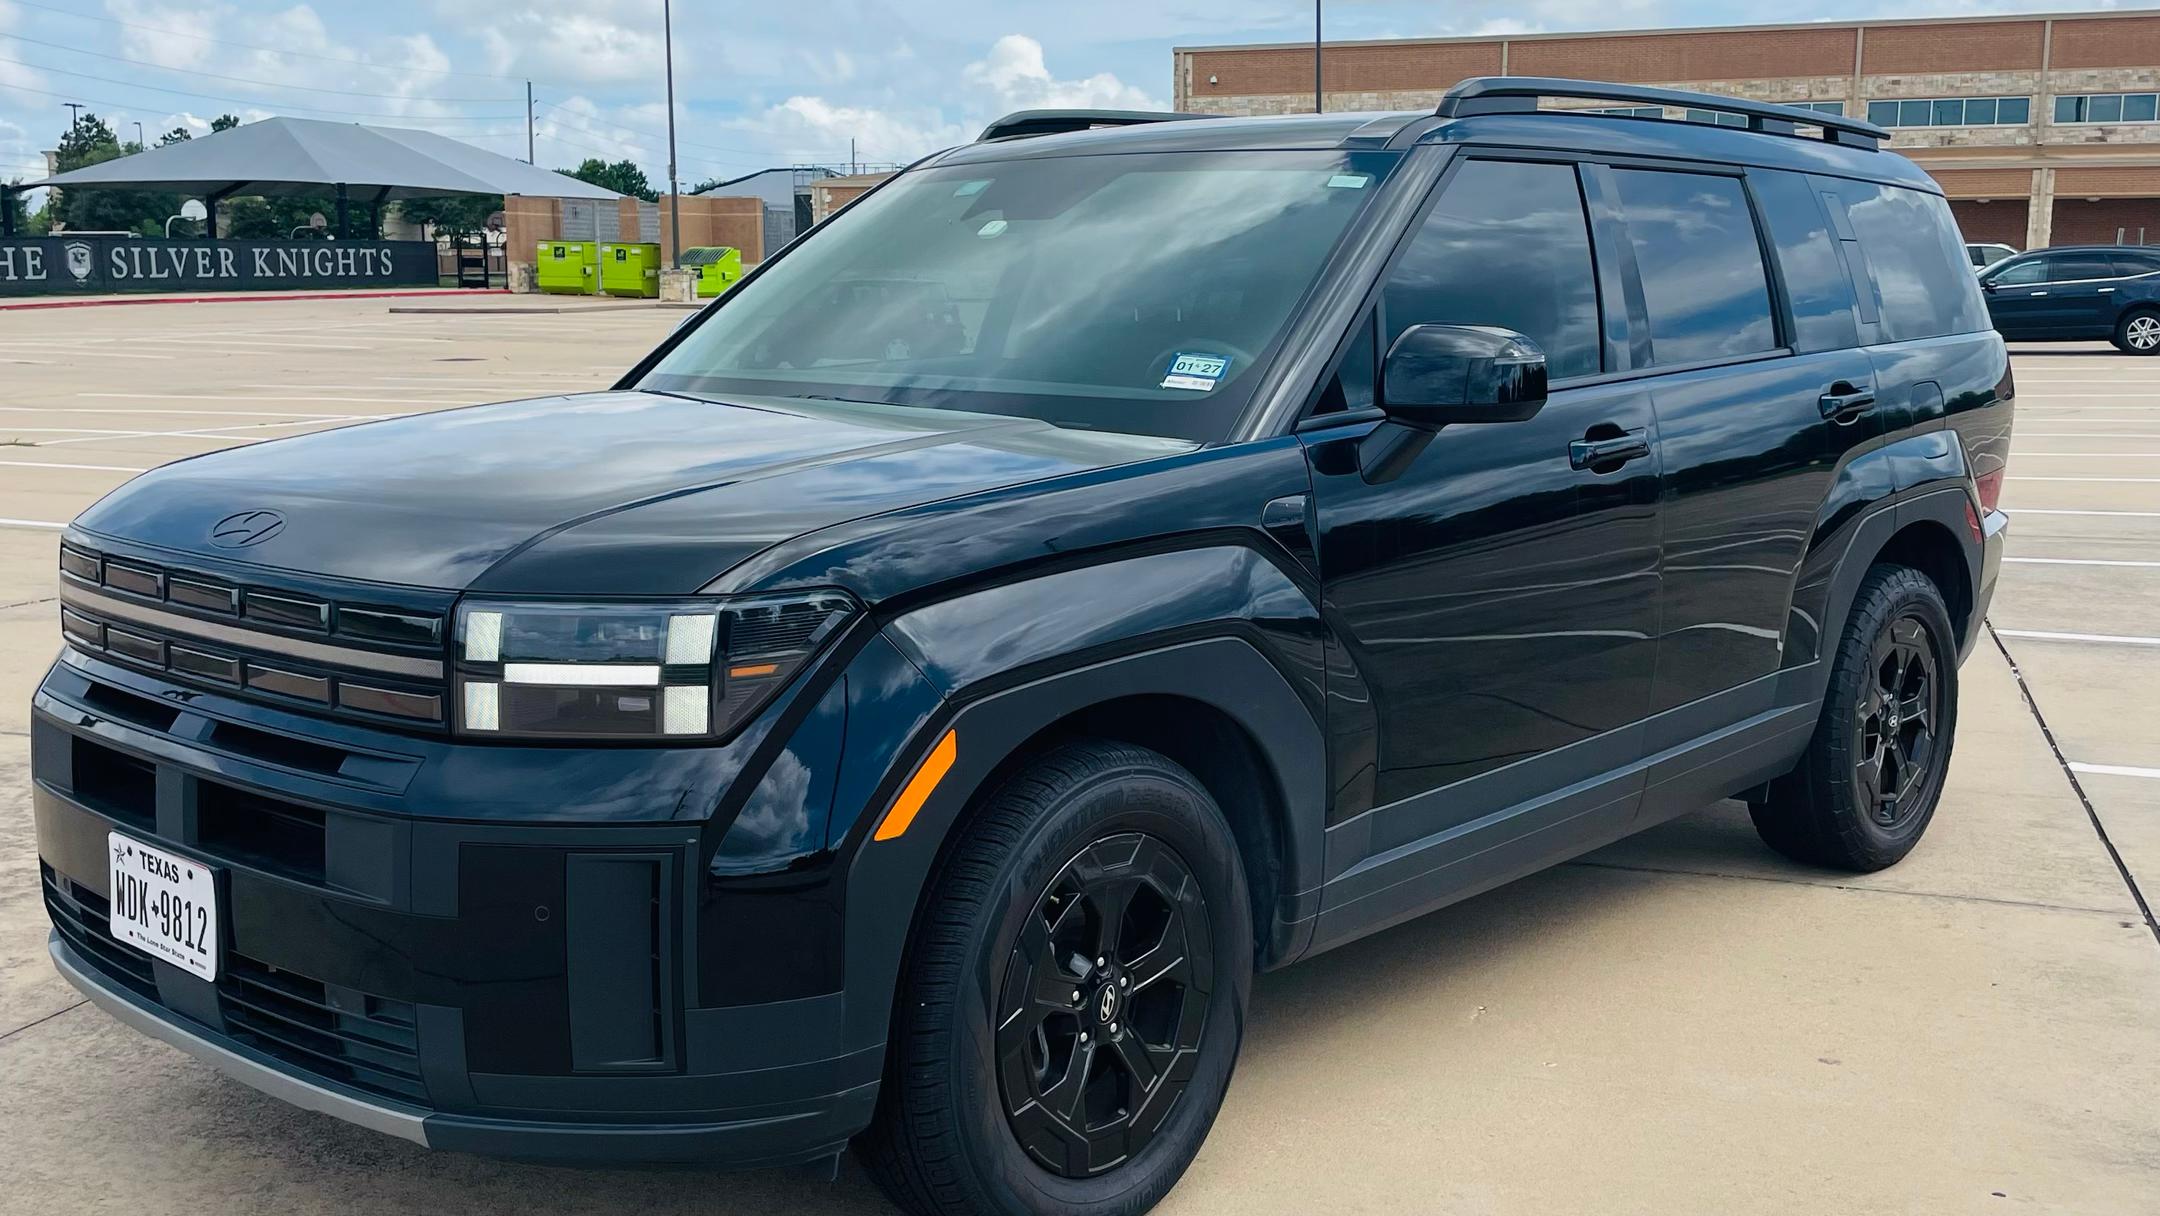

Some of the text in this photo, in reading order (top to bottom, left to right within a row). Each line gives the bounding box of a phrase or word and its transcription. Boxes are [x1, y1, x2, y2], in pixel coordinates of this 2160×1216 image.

[111, 247, 238, 279] SILVER
[252, 247, 393, 278] KNIGHTS
[139, 850, 180, 884] TEXAS
